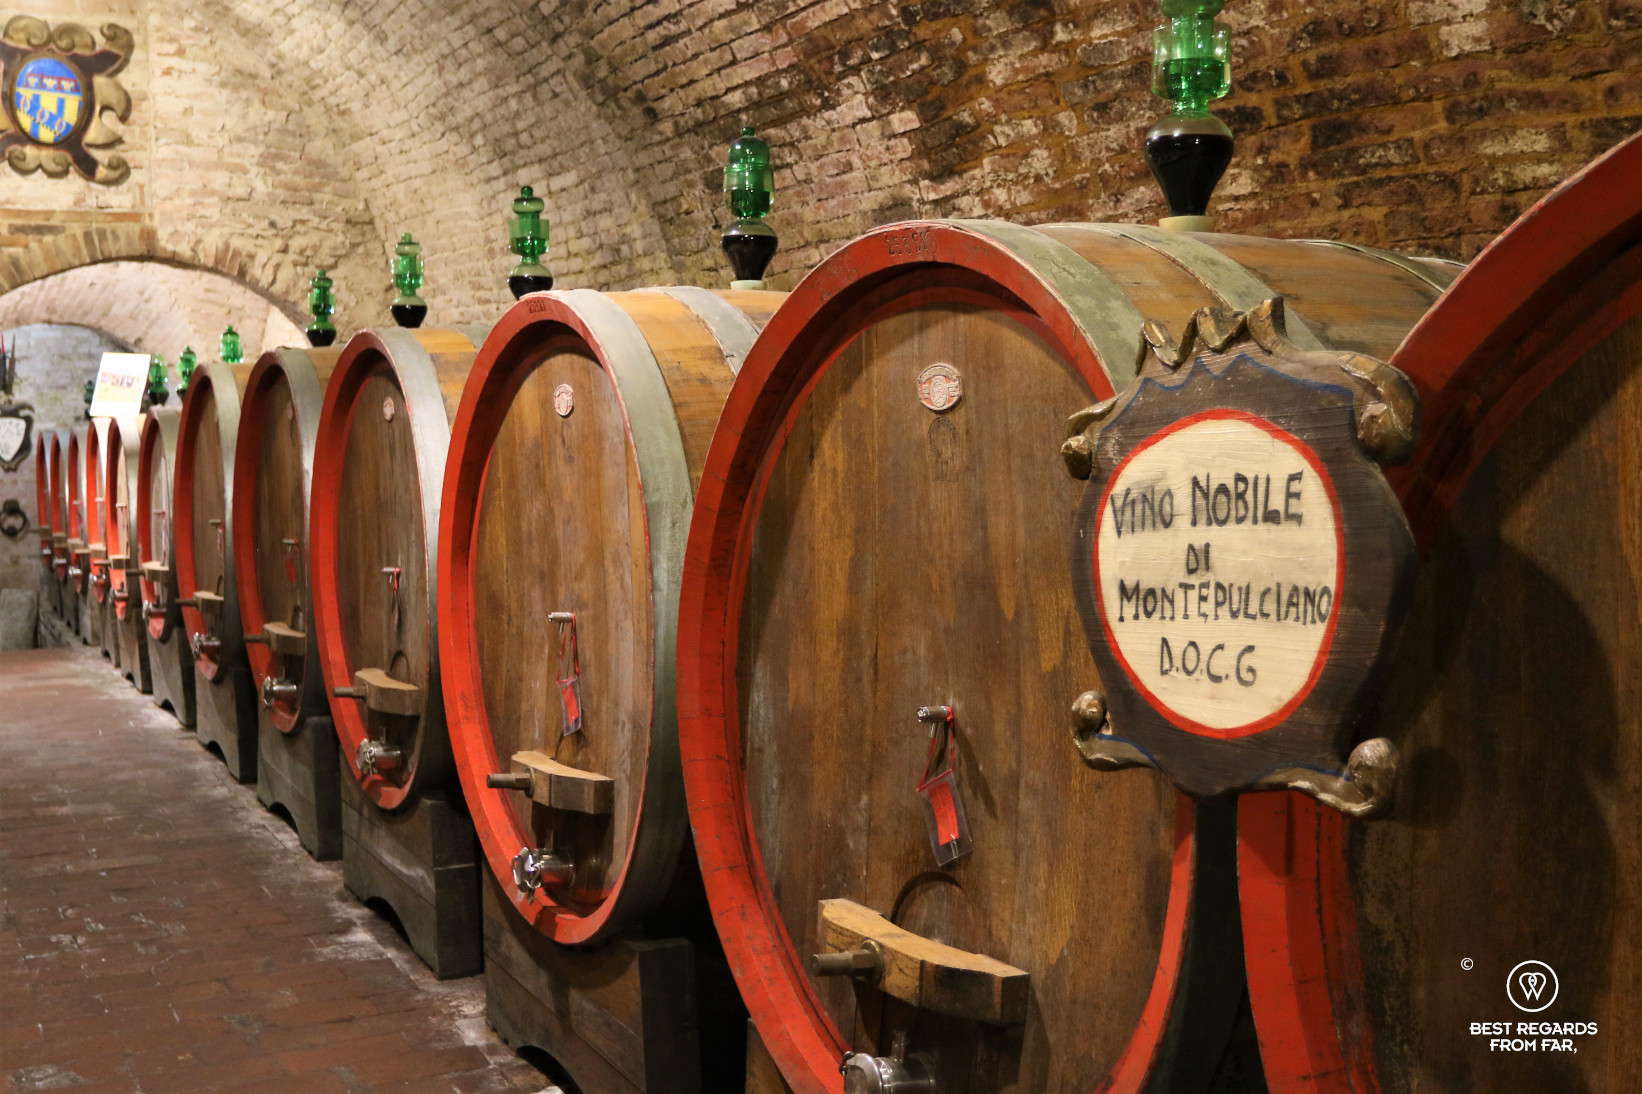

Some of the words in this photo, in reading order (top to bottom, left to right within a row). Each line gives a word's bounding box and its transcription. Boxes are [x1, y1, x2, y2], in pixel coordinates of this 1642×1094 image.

[1110, 487, 1174, 538] VINO
[1190, 470, 1304, 527] NOBILE
[1185, 542, 1211, 575] DI
[1118, 579, 1332, 626] MONTEPULCIANO
